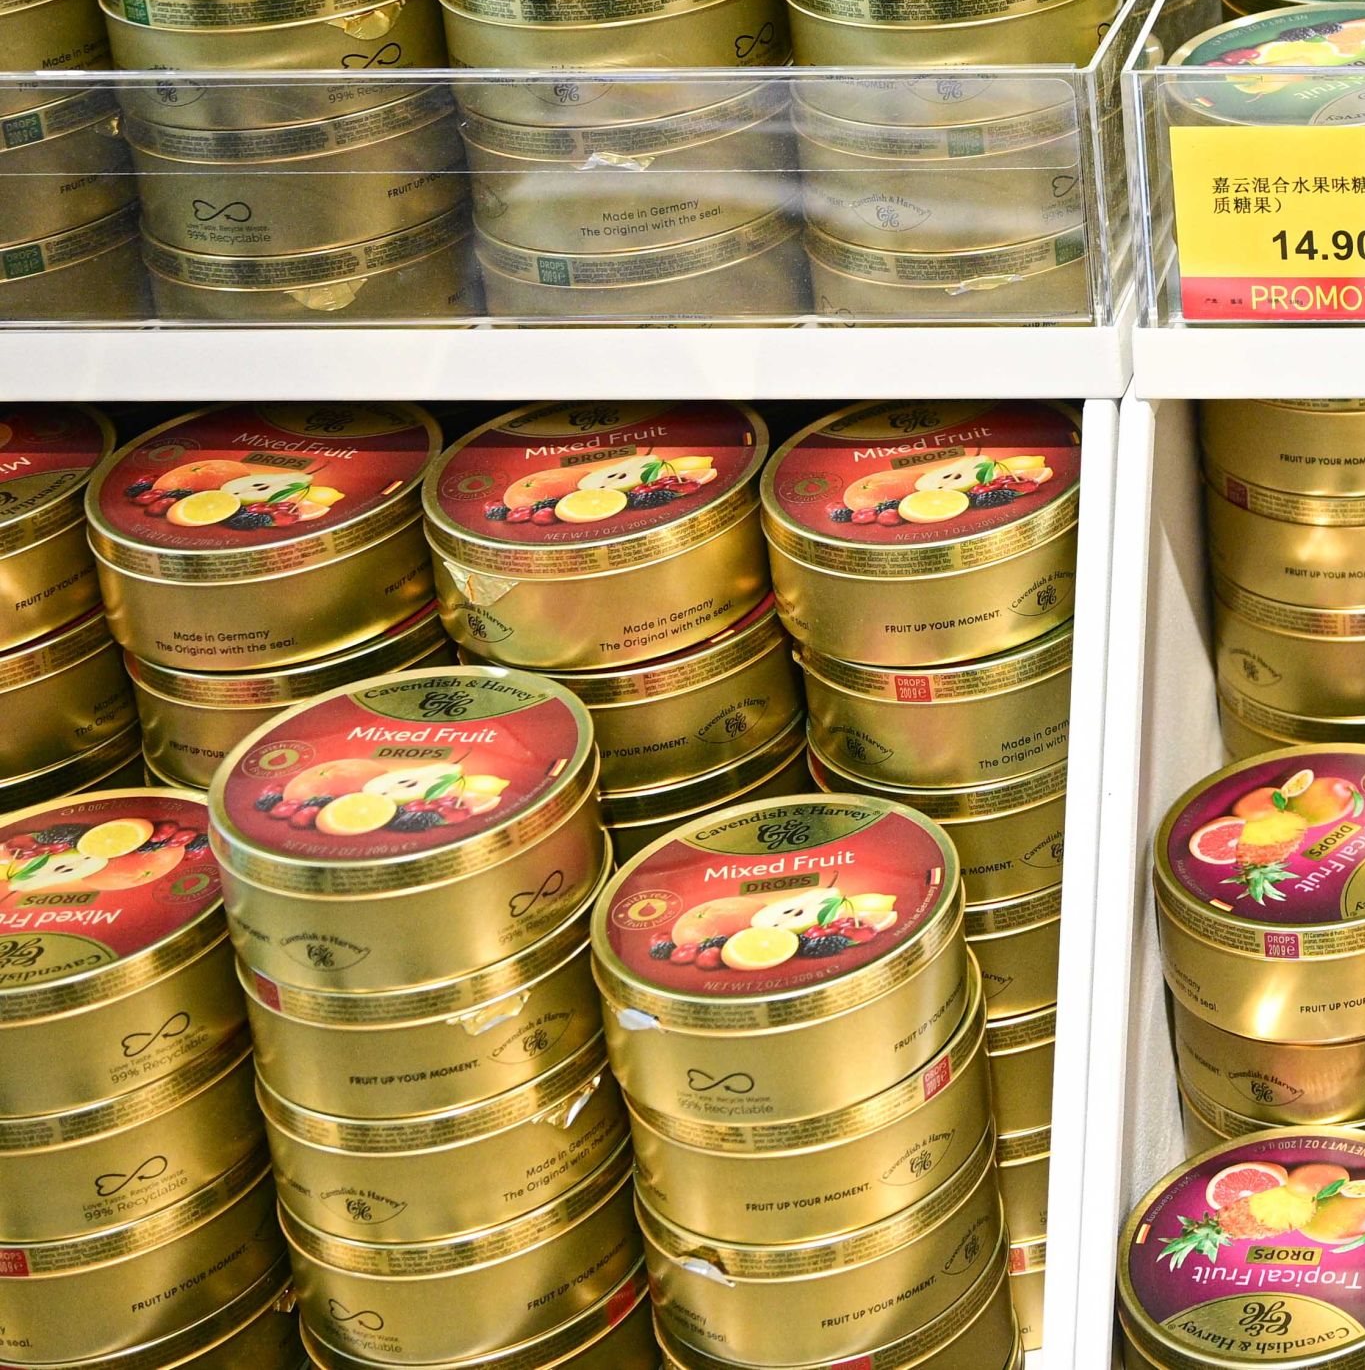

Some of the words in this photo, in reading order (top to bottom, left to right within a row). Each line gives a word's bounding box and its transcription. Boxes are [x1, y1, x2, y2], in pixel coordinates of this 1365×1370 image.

[602, 211, 634, 222] Made
[638, 210, 648, 220] in
[650, 199, 700, 219] Germany
[580, 226, 600, 237] The
[603, 221, 648, 238] Original
[652, 220, 676, 230] with
[678, 214, 696, 224] the
[233, 432, 298, 452] Mixed
[300, 435, 359, 460] Fruit
[524, 438, 601, 460] Mixed
[608, 425, 667, 446] Fruit
[853, 438, 927, 461] Mixed
[932, 425, 992, 447] Fruit
[251, 456, 306, 469] DROPS
[565, 448, 631, 465] DROPS
[898, 448, 959, 467] DROPS
[884, 622, 915, 633] FRUIT
[918, 621, 931, 630] UP
[934, 617, 957, 629] YOUR
[363, 676, 459, 699] Cavendish
[347, 726, 427, 743] Mixed
[431, 728, 497, 743] Fruit
[378, 748, 445, 758] DROPS
[1306, 824, 1353, 857] DROPS
[703, 858, 786, 882] Mixed
[792, 850, 855, 871] Fruit
[1294, 858, 1345, 893] Fruit
[745, 875, 813, 892] DROPS
[1300, 1003, 1328, 1013] FRUIT
[1330, 1002, 1340, 1010] UP
[1255, 1249, 1315, 1261] DROPS
[1192, 1263, 1251, 1285] Fruit
[1260, 1270, 1363, 1290] Tropical
